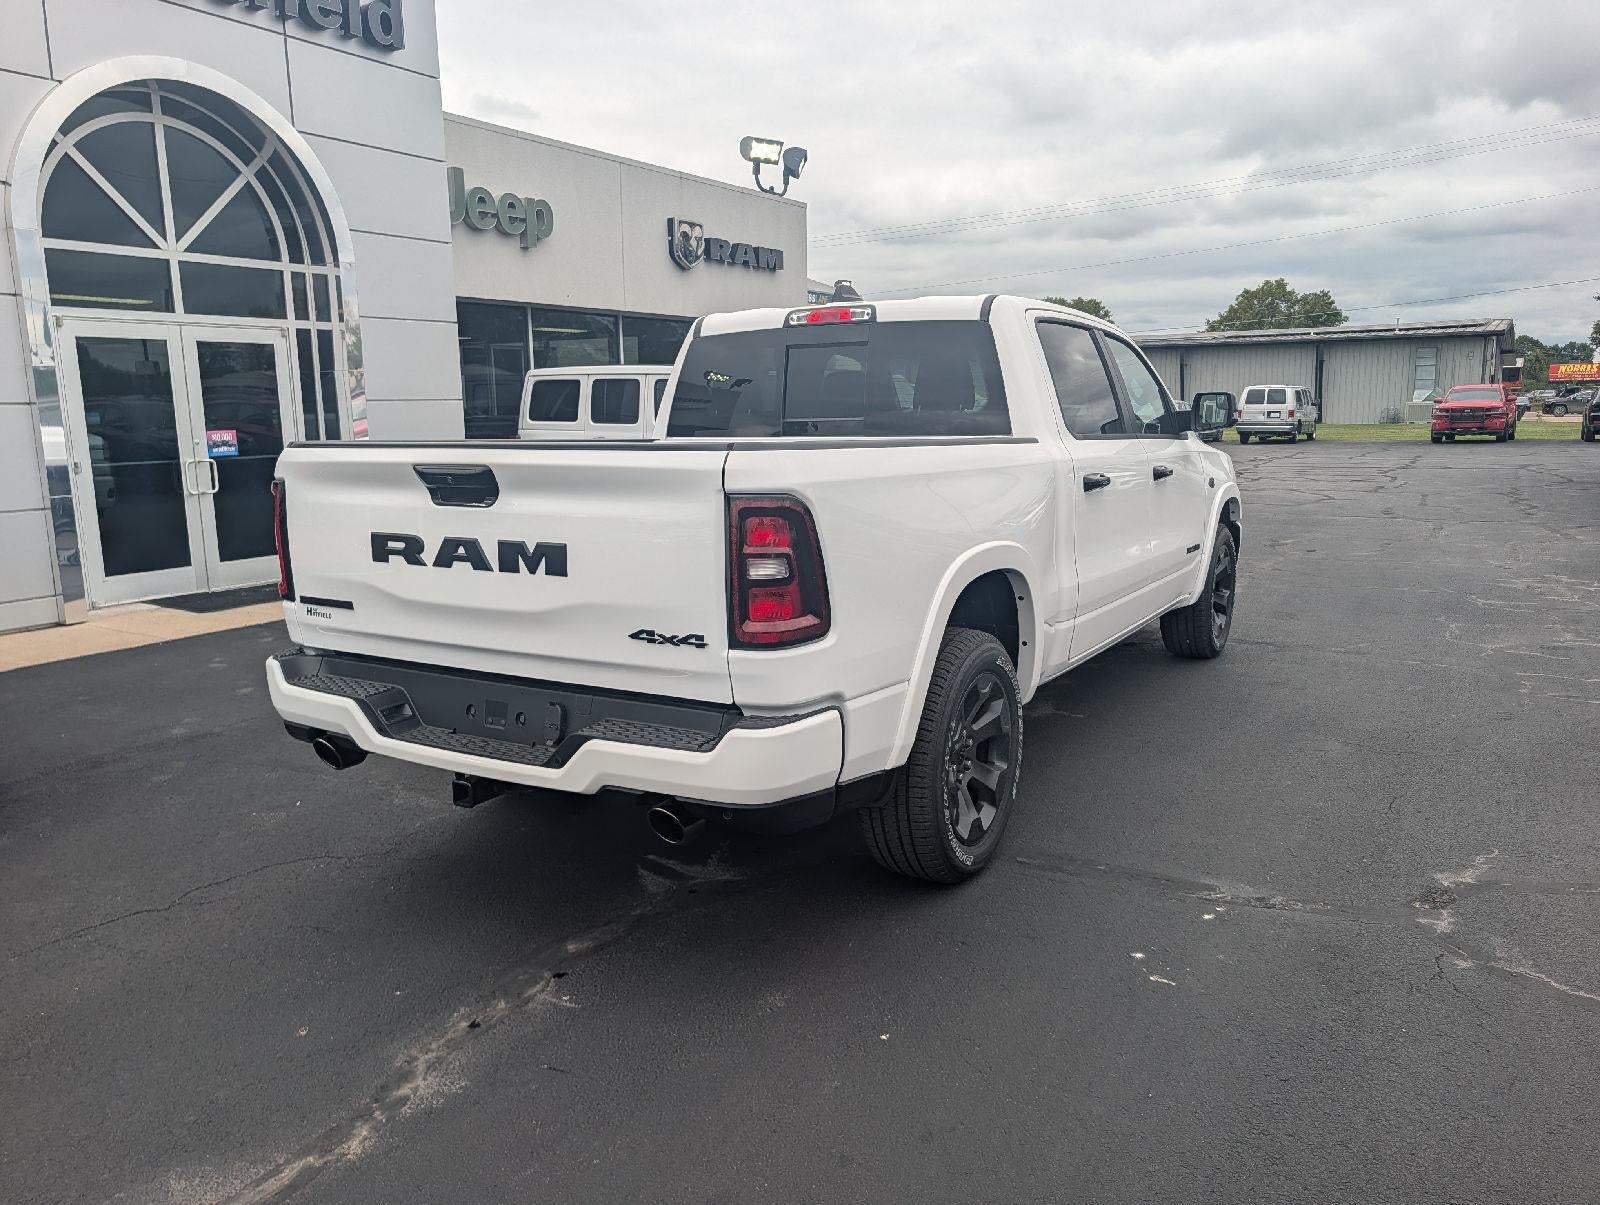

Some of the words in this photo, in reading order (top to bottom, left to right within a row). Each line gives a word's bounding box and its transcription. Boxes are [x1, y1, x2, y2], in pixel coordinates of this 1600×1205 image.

[446, 166, 554, 249] Jeep
[703, 237, 784, 271] RAM
[1558, 363, 1599, 373] NORRIS
[370, 531, 569, 578] RAM
[627, 629, 710, 649] 4x4
